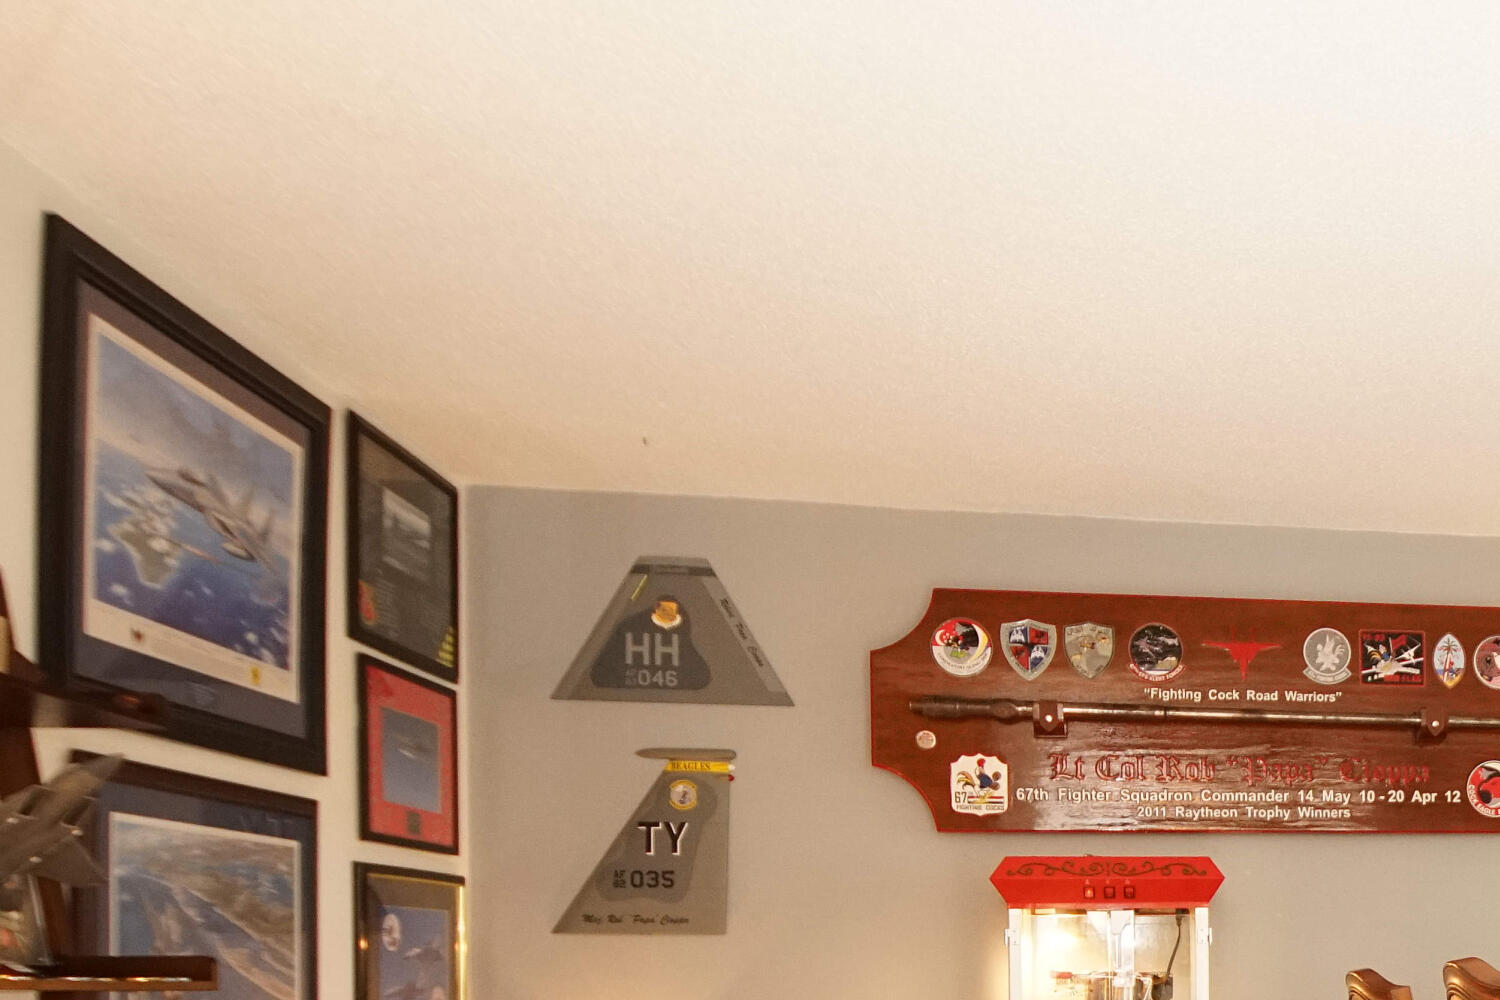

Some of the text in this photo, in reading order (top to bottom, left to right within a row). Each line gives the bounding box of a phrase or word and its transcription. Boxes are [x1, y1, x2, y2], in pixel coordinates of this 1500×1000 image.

[625, 632, 680, 667] HH
[638, 669, 679, 687] 046
[1144, 688, 1342, 703] "Fighting Cock Road Warriors"
[671, 760, 711, 770] BEAGLES
[1049, 753, 1086, 782] Lt
[1095, 754, 1147, 782] Col
[1156, 754, 1216, 782] Rob
[1016, 788, 1049, 801] 67th
[1058, 788, 1111, 804] Fighter
[1120, 789, 1192, 804] Squadron
[1201, 789, 1289, 803] Commander
[1297, 790, 1314, 803] 14
[1322, 790, 1351, 805] May
[1412, 790, 1436, 805] Apr
[1445, 791, 1462, 803] 12
[1136, 806, 1351, 820] 2011 Raytheon Trophy Winners
[638, 821, 689, 856] TY
[630, 870, 675, 888] 035
